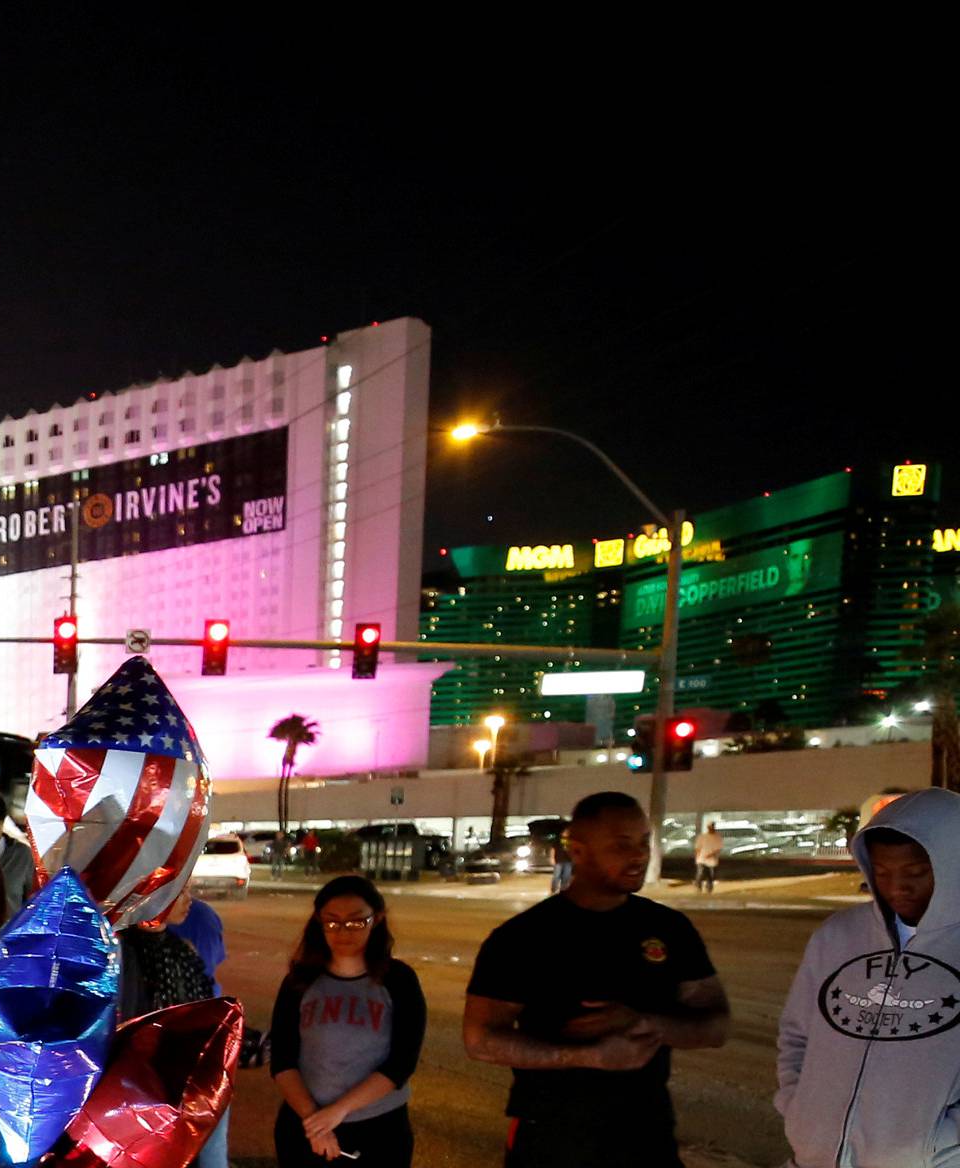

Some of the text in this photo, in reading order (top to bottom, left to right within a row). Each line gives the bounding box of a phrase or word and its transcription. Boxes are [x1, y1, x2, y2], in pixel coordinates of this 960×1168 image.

[114, 474, 222, 523] IRVINE'S
[242, 495, 285, 518] NOW
[242, 514, 284, 535] OPEN
[505, 544, 575, 571] MGM
[636, 593, 666, 617] DAVI
[865, 955, 932, 980] FLY
[300, 993, 385, 1034] UNLV
[856, 1009, 904, 1027] SOCIETY
